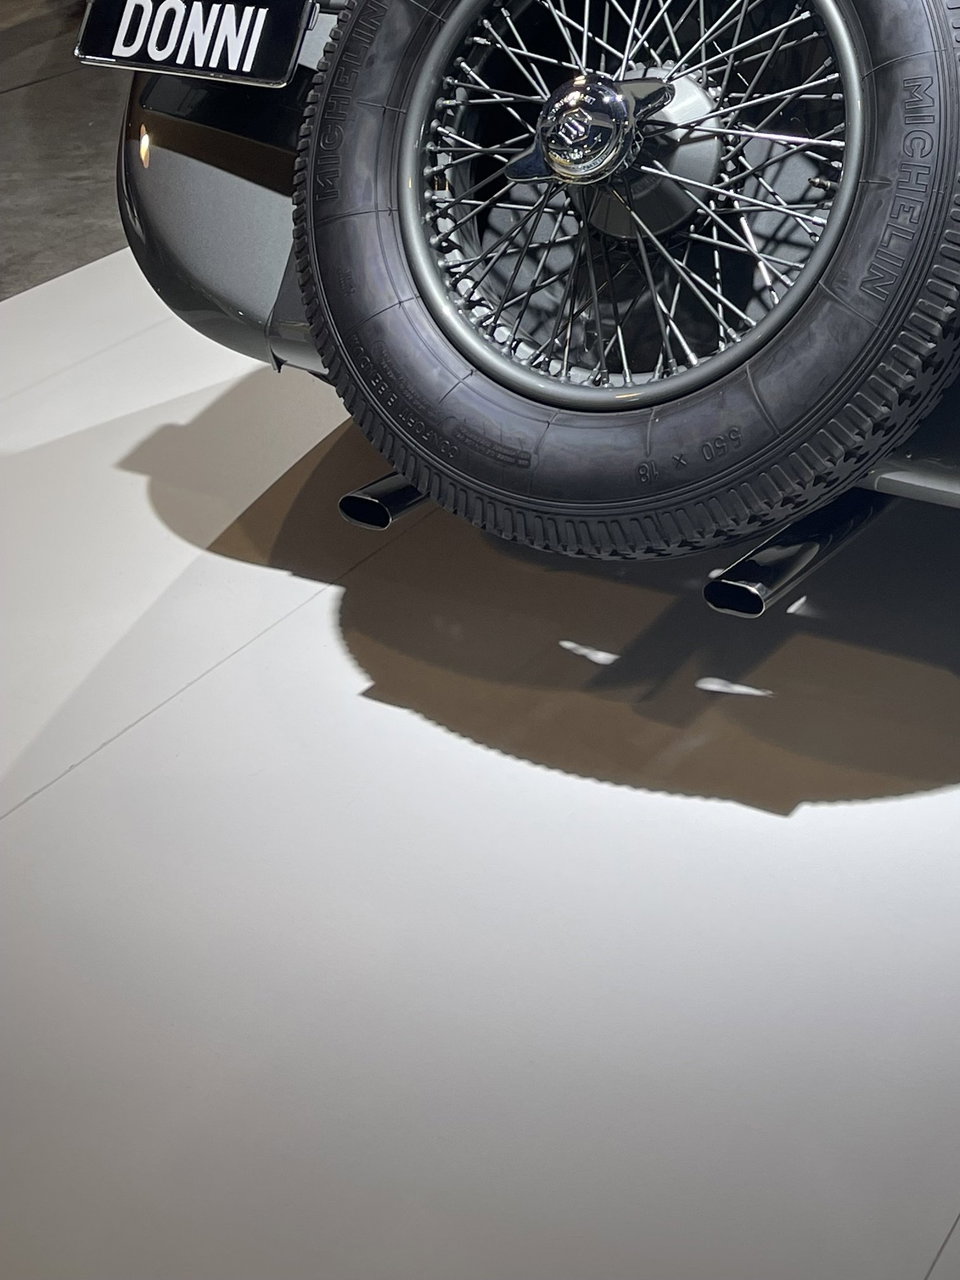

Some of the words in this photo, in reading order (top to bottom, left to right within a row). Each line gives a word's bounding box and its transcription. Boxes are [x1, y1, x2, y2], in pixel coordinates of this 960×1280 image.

[860, 75, 936, 302] MICHELIN
[701, 425, 742, 461] 550
[638, 461, 660, 483] 18
